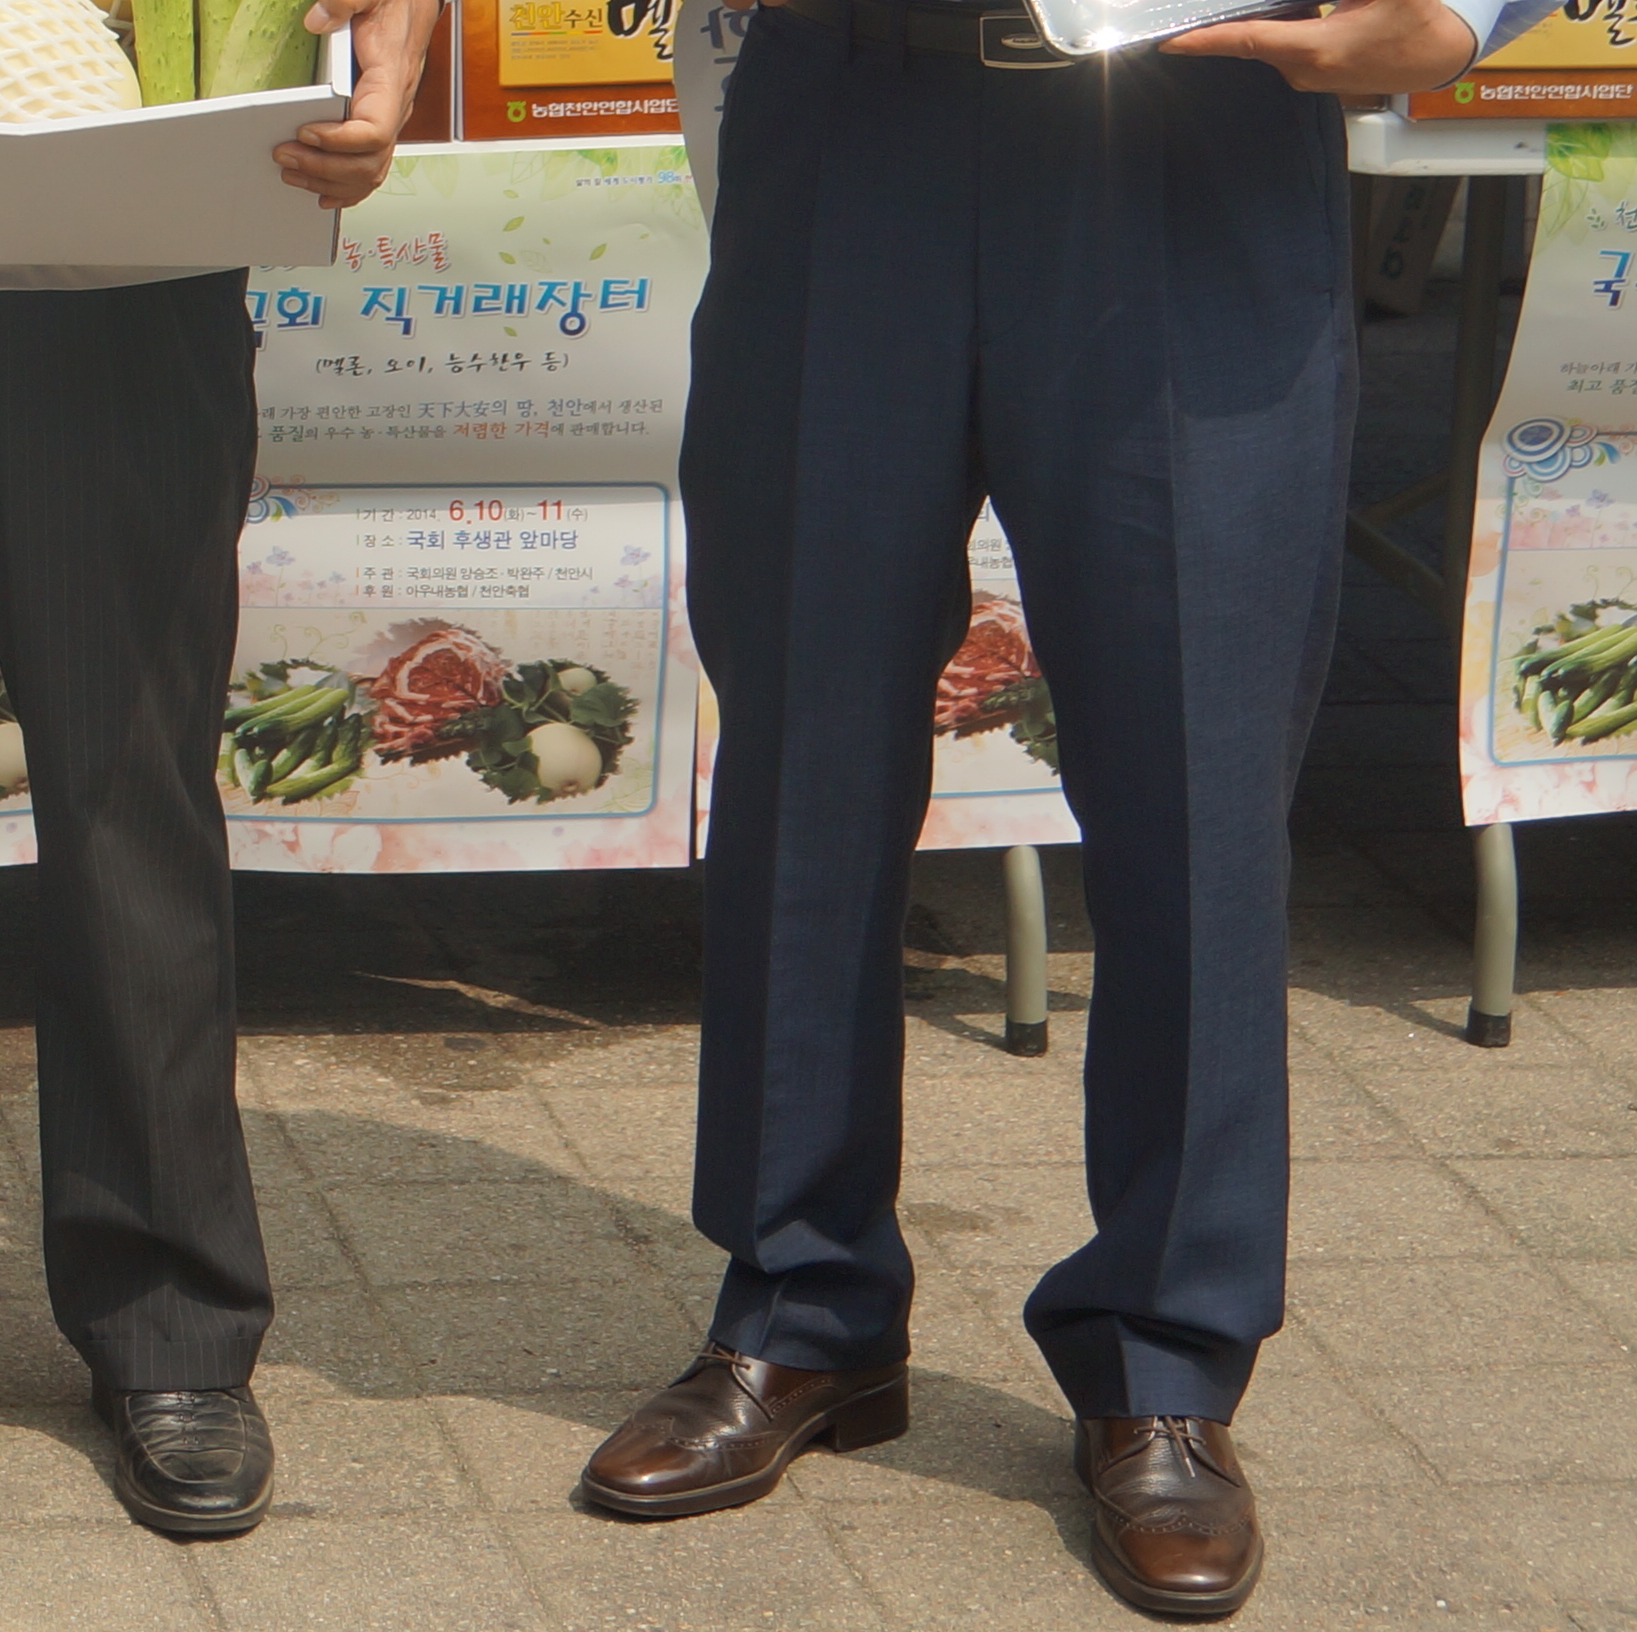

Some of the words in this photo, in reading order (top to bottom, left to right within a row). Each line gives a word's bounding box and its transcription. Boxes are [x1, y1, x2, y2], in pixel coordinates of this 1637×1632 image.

[360, 278, 650, 338] 직거래장터
[445, 353, 531, 375] 능수한우
[406, 529, 446, 550] 국회
[452, 529, 512, 550] 후생관
[519, 529, 578, 550] 앞마당
[407, 566, 457, 581] 국회의원
[554, 566, 594, 581] 천안시
